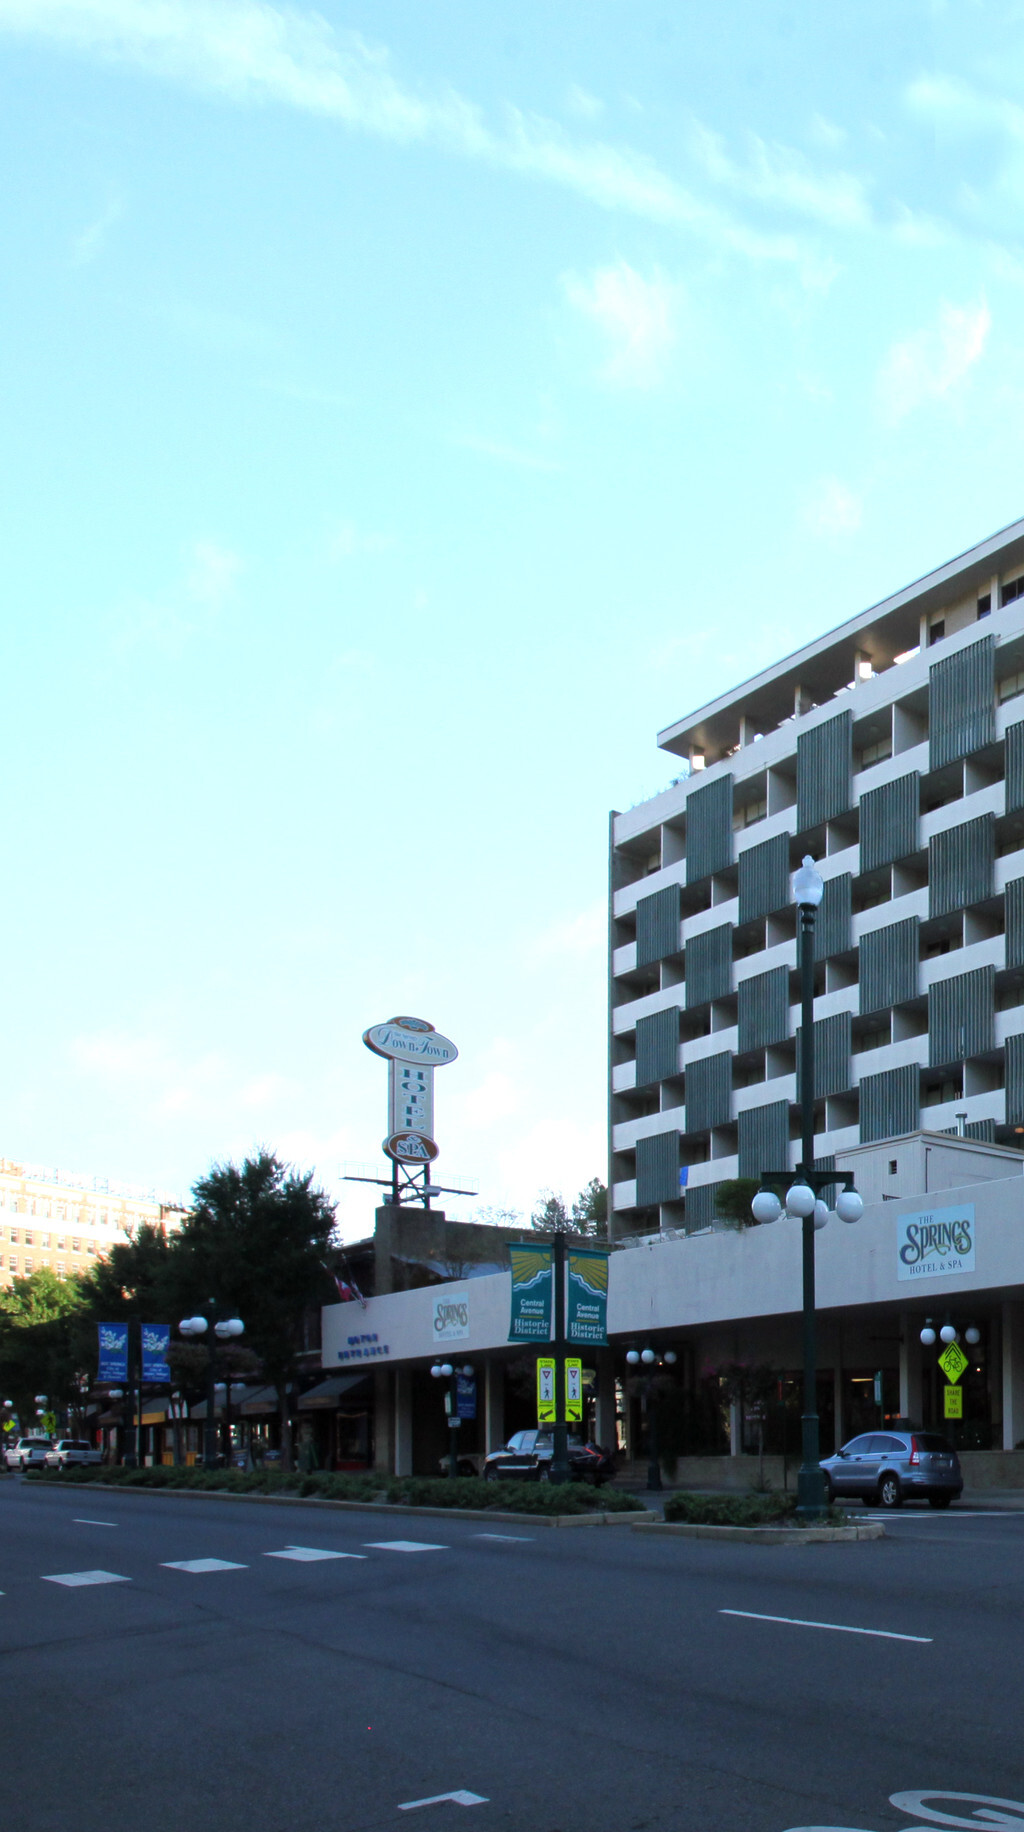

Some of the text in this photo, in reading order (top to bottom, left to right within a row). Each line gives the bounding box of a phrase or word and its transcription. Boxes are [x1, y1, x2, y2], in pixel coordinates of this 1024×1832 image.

[401, 1067, 427, 1130] HOTEL
[396, 1141, 429, 1158] SPA
[918, 1214, 935, 1225] THE
[899, 1219, 972, 1265] SPRINGS
[909, 1259, 963, 1275] HOTEL & SPA
[520, 1298, 545, 1307] Central
[576, 1303, 600, 1312] Central
[520, 1306, 544, 1314] Avenue
[576, 1311, 600, 1319] Avenue
[514, 1318, 550, 1328] Historic
[570, 1322, 605, 1333] Historic
[514, 1326, 548, 1335] District
[571, 1330, 604, 1339] District
